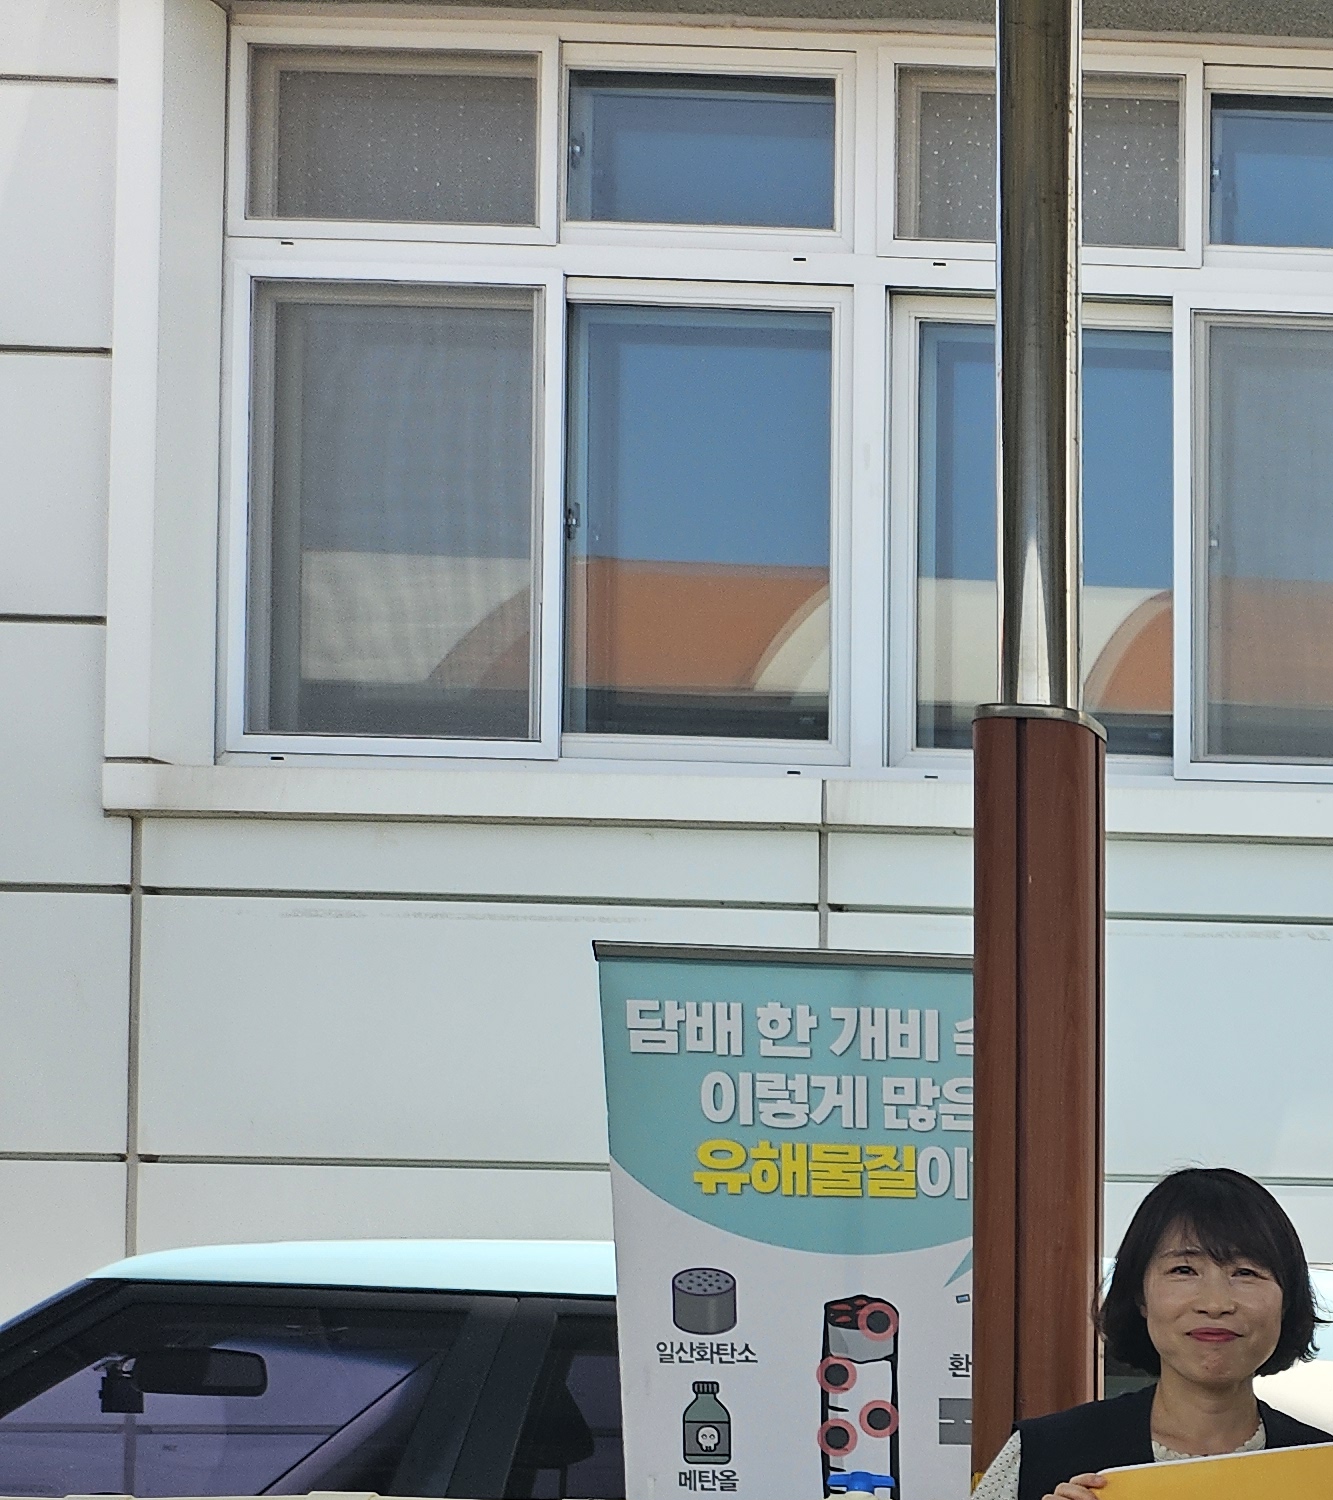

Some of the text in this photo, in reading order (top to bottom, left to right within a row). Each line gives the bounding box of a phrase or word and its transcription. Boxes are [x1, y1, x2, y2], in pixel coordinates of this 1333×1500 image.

[625, 1000, 743, 1057] 담배
[755, 1002, 817, 1059] 한
[829, 1006, 939, 1061] 개비
[701, 1070, 868, 1129] 이렇게
[656, 1342, 758, 1365] 일산화탄소
[679, 1470, 739, 1492] 메탄올
